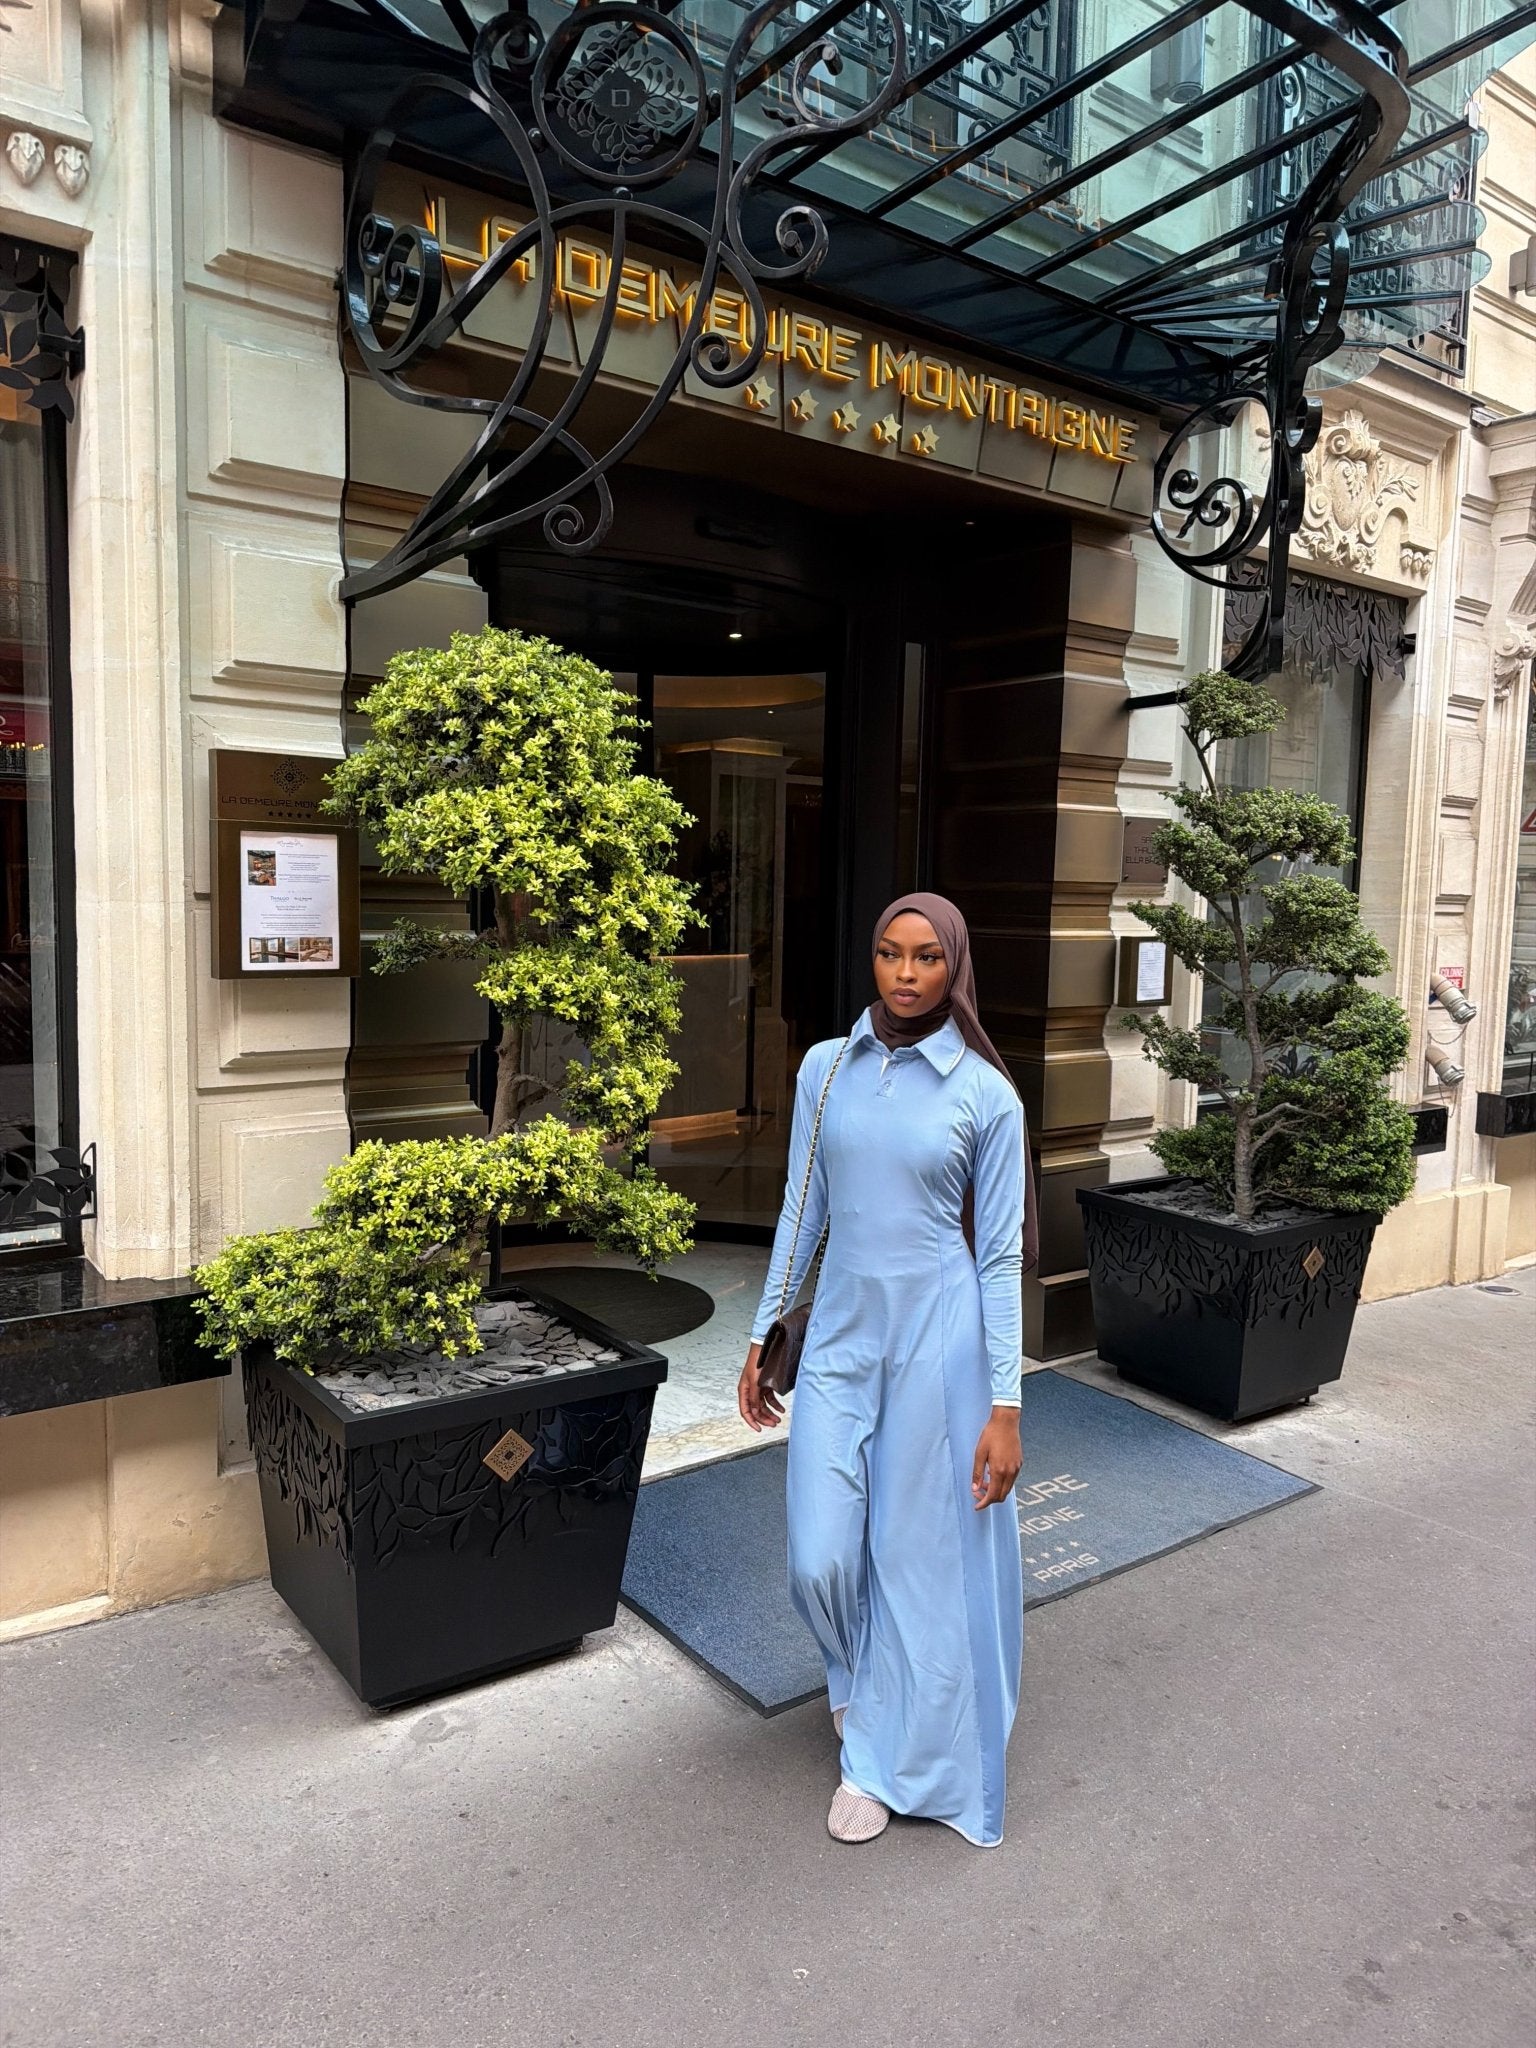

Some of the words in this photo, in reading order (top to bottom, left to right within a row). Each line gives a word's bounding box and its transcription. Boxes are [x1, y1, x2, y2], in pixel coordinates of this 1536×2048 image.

[432, 196, 536, 282] LA
[557, 236, 863, 380] DEMEURE
[872, 341, 1140, 463] MONTAIGNE
[221, 795, 236, 804] LA
[240, 796, 293, 808] DEMEURE
[295, 801, 318, 809] MON
[1017, 1474, 1090, 1509] URE
[1033, 1552, 1100, 1582] PARIS
